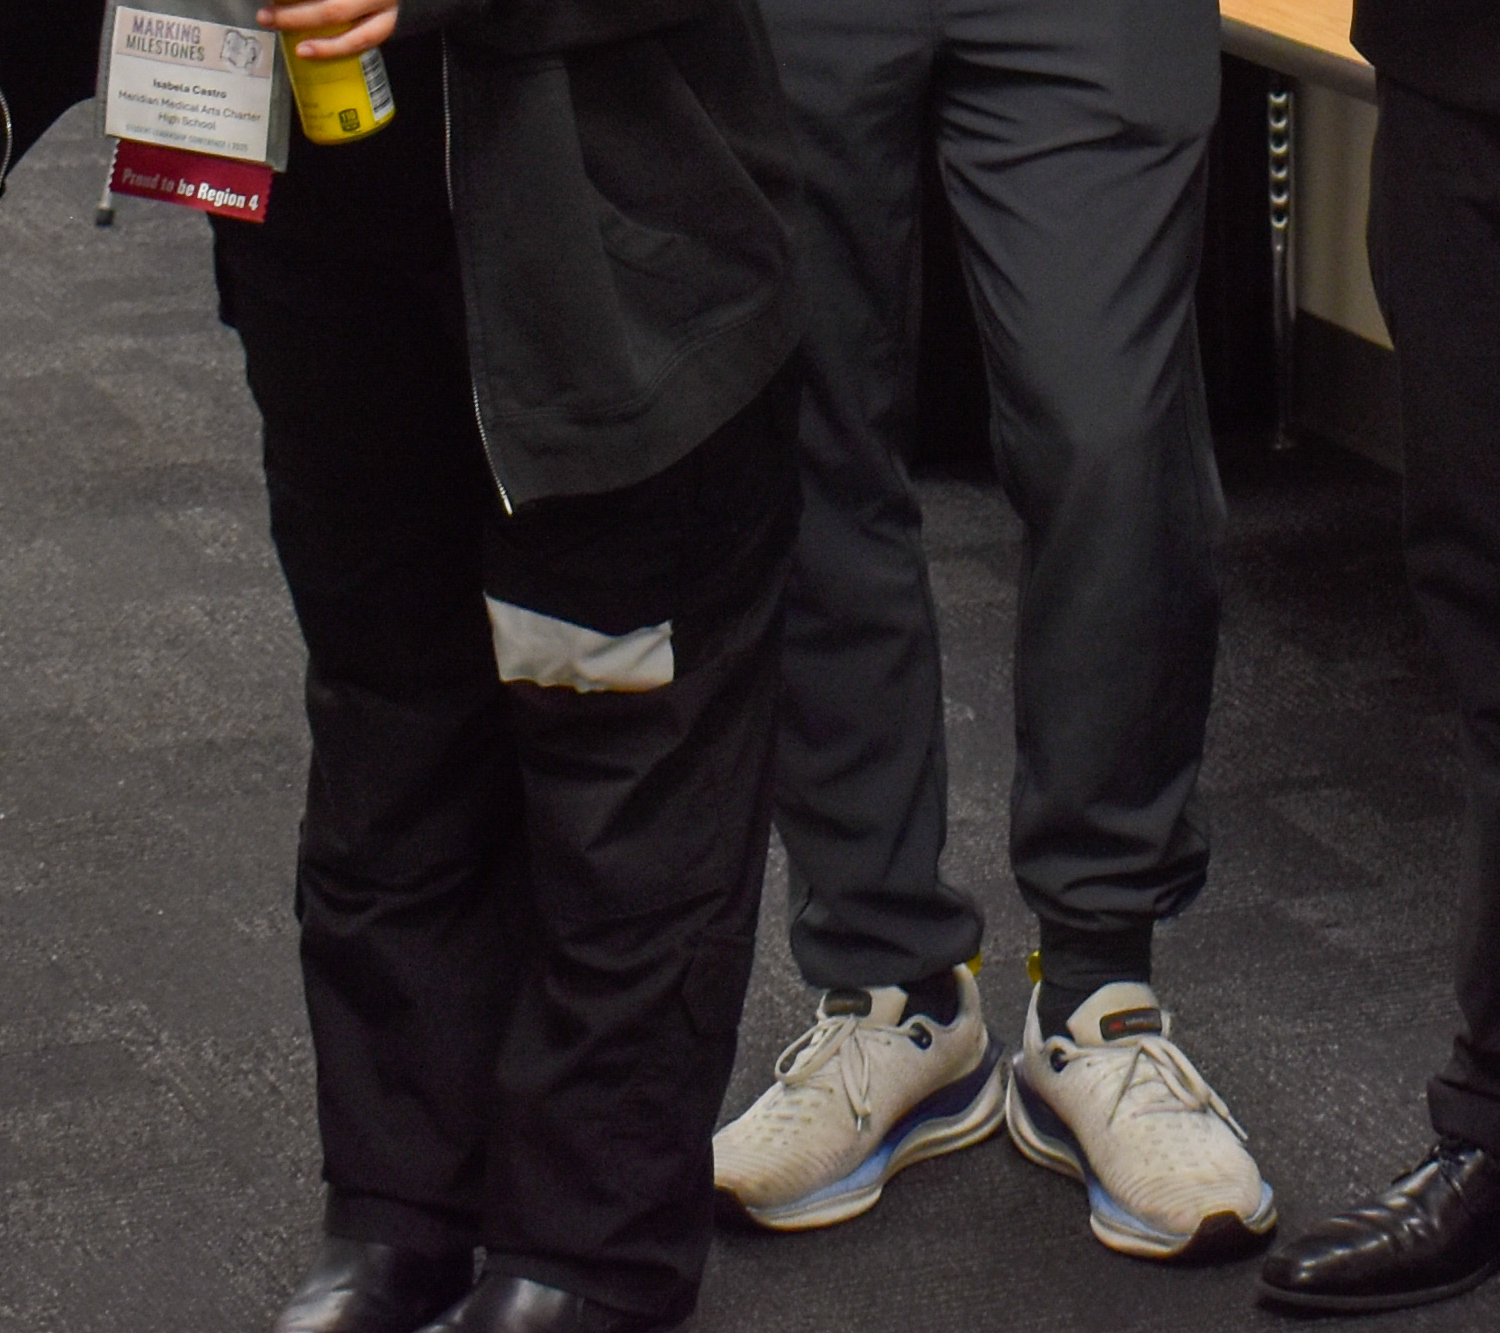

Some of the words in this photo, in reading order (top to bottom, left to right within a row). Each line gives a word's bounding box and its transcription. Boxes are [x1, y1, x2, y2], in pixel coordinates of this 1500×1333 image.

[132, 15, 202, 45] MARKING
[126, 34, 205, 62] MILESTONES
[153, 78, 190, 93] Isabela
[192, 85, 227, 99] Castro
[197, 182, 246, 209] Region
